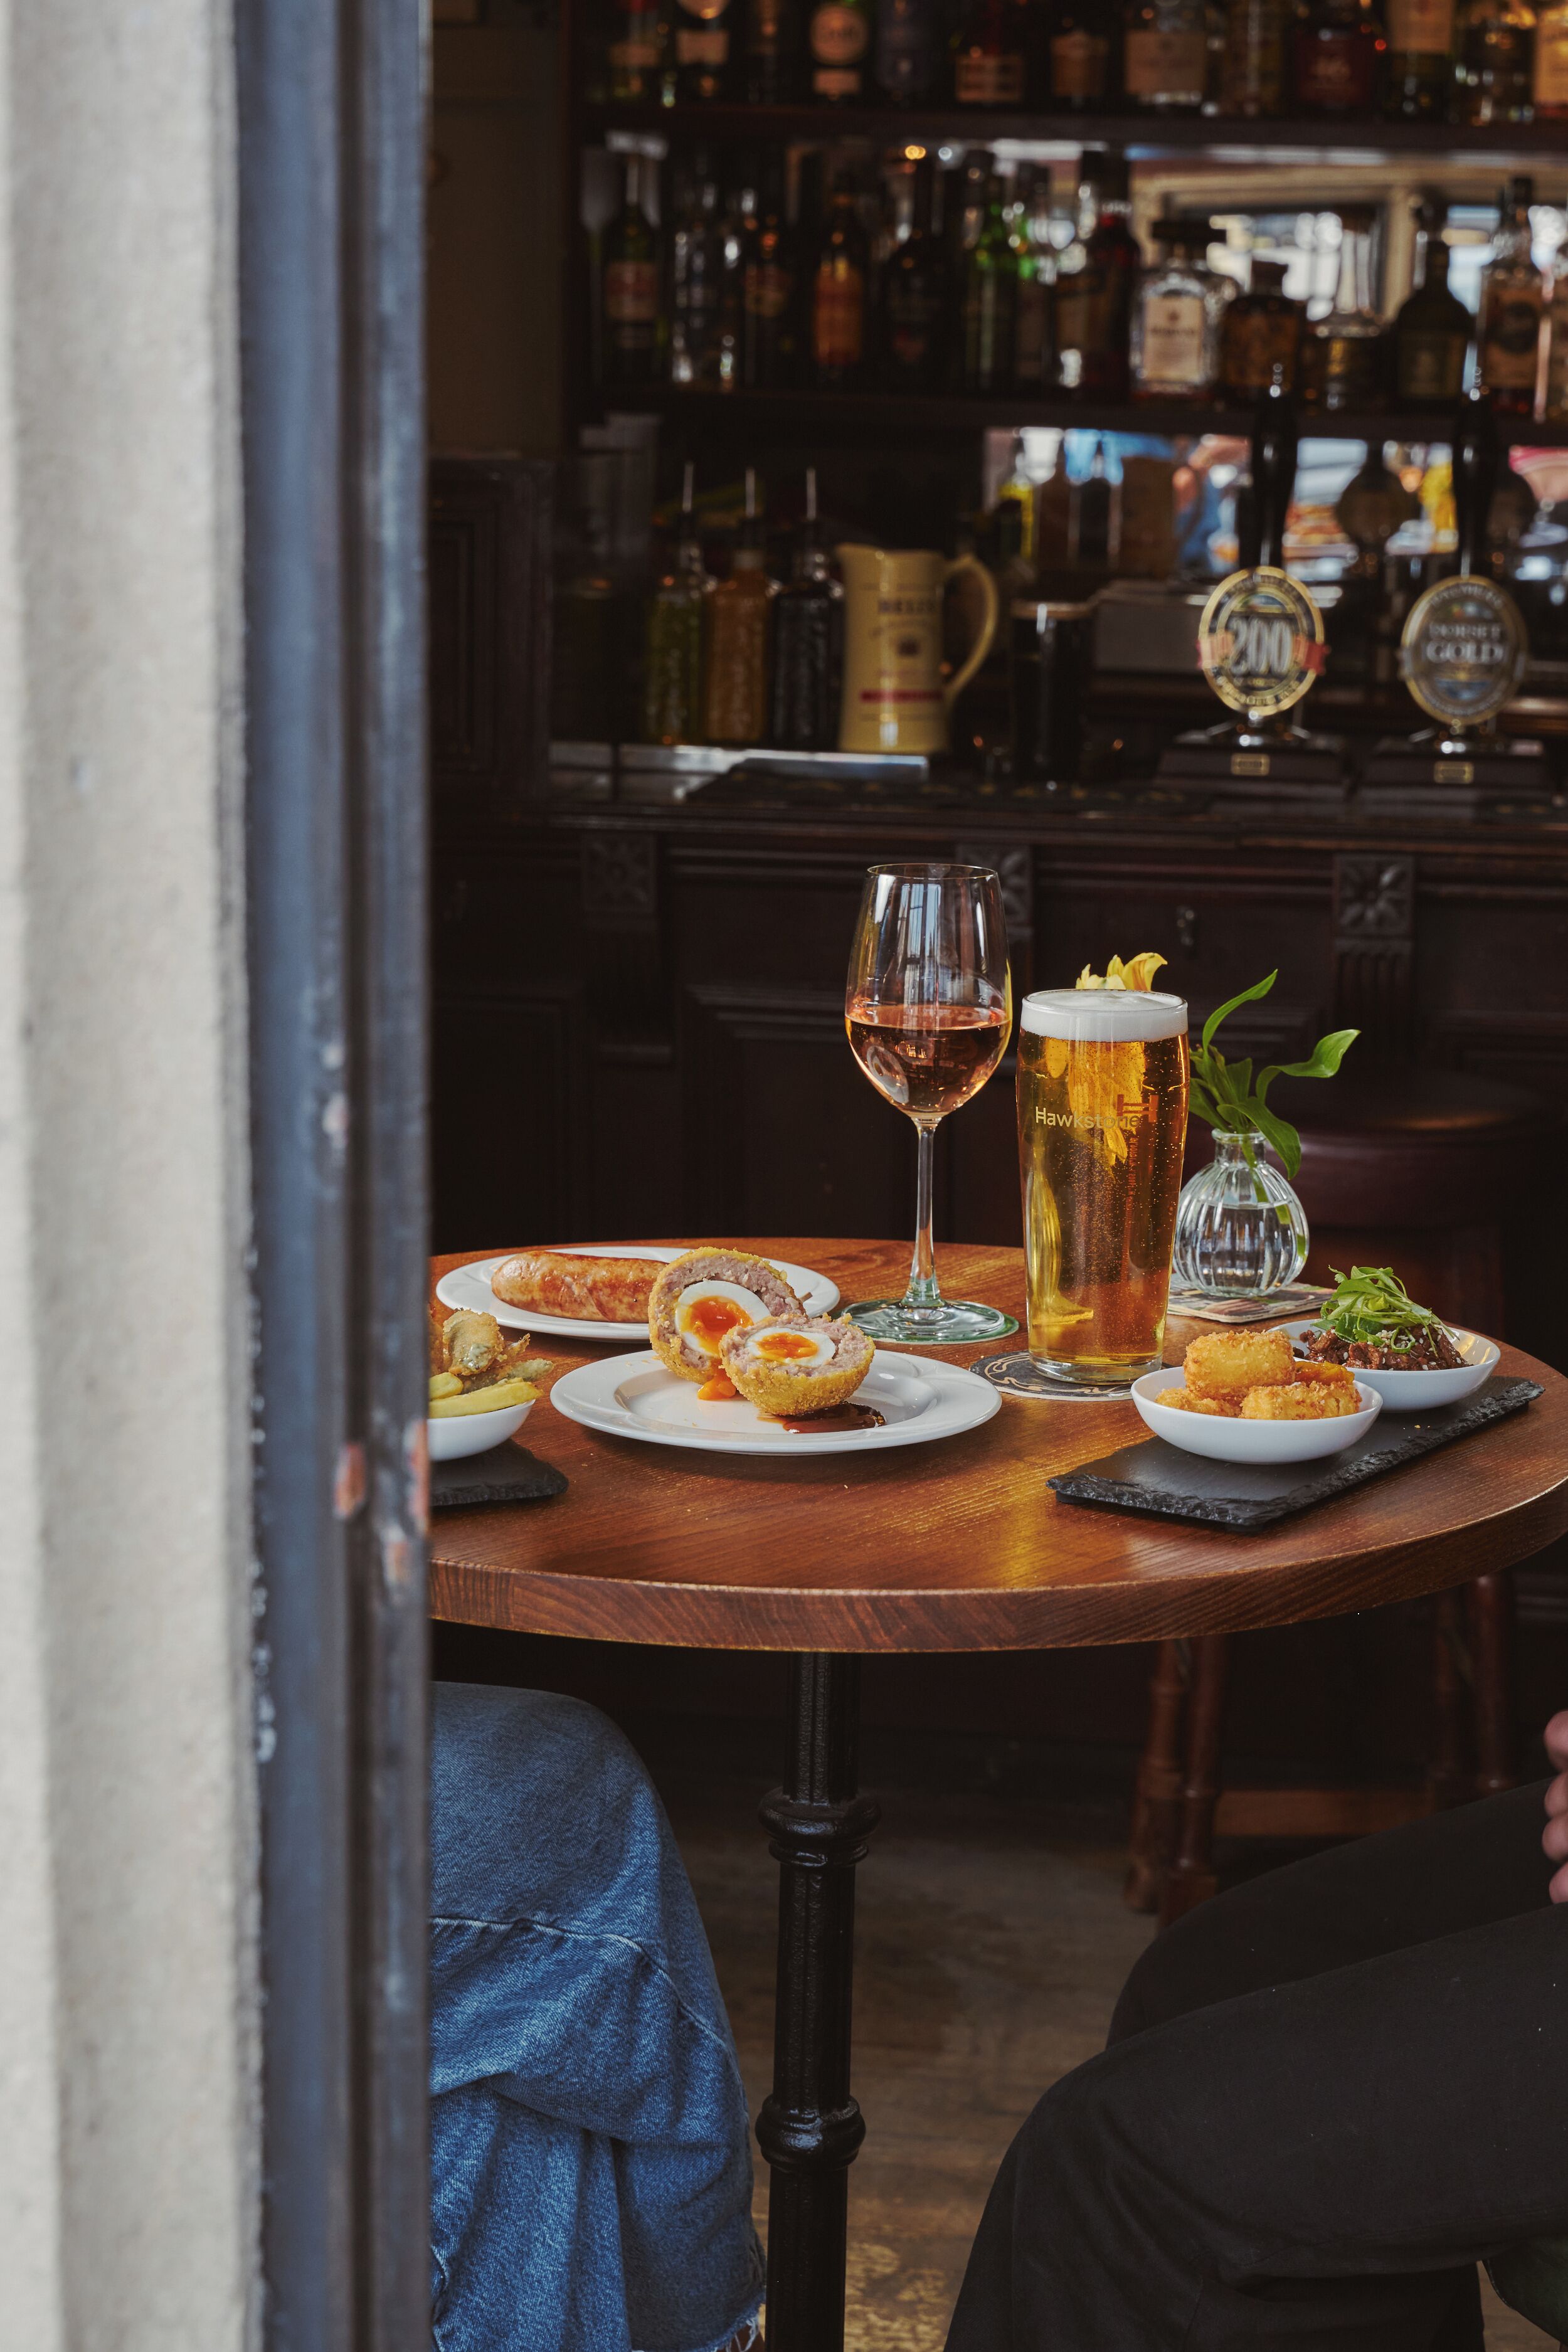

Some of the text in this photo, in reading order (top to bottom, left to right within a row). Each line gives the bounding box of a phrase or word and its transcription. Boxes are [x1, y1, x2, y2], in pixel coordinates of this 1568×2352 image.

[1227, 617, 1293, 675] 200
[1426, 640, 1504, 664] GOLD
[1035, 1106, 1142, 1129] Hawkstone
